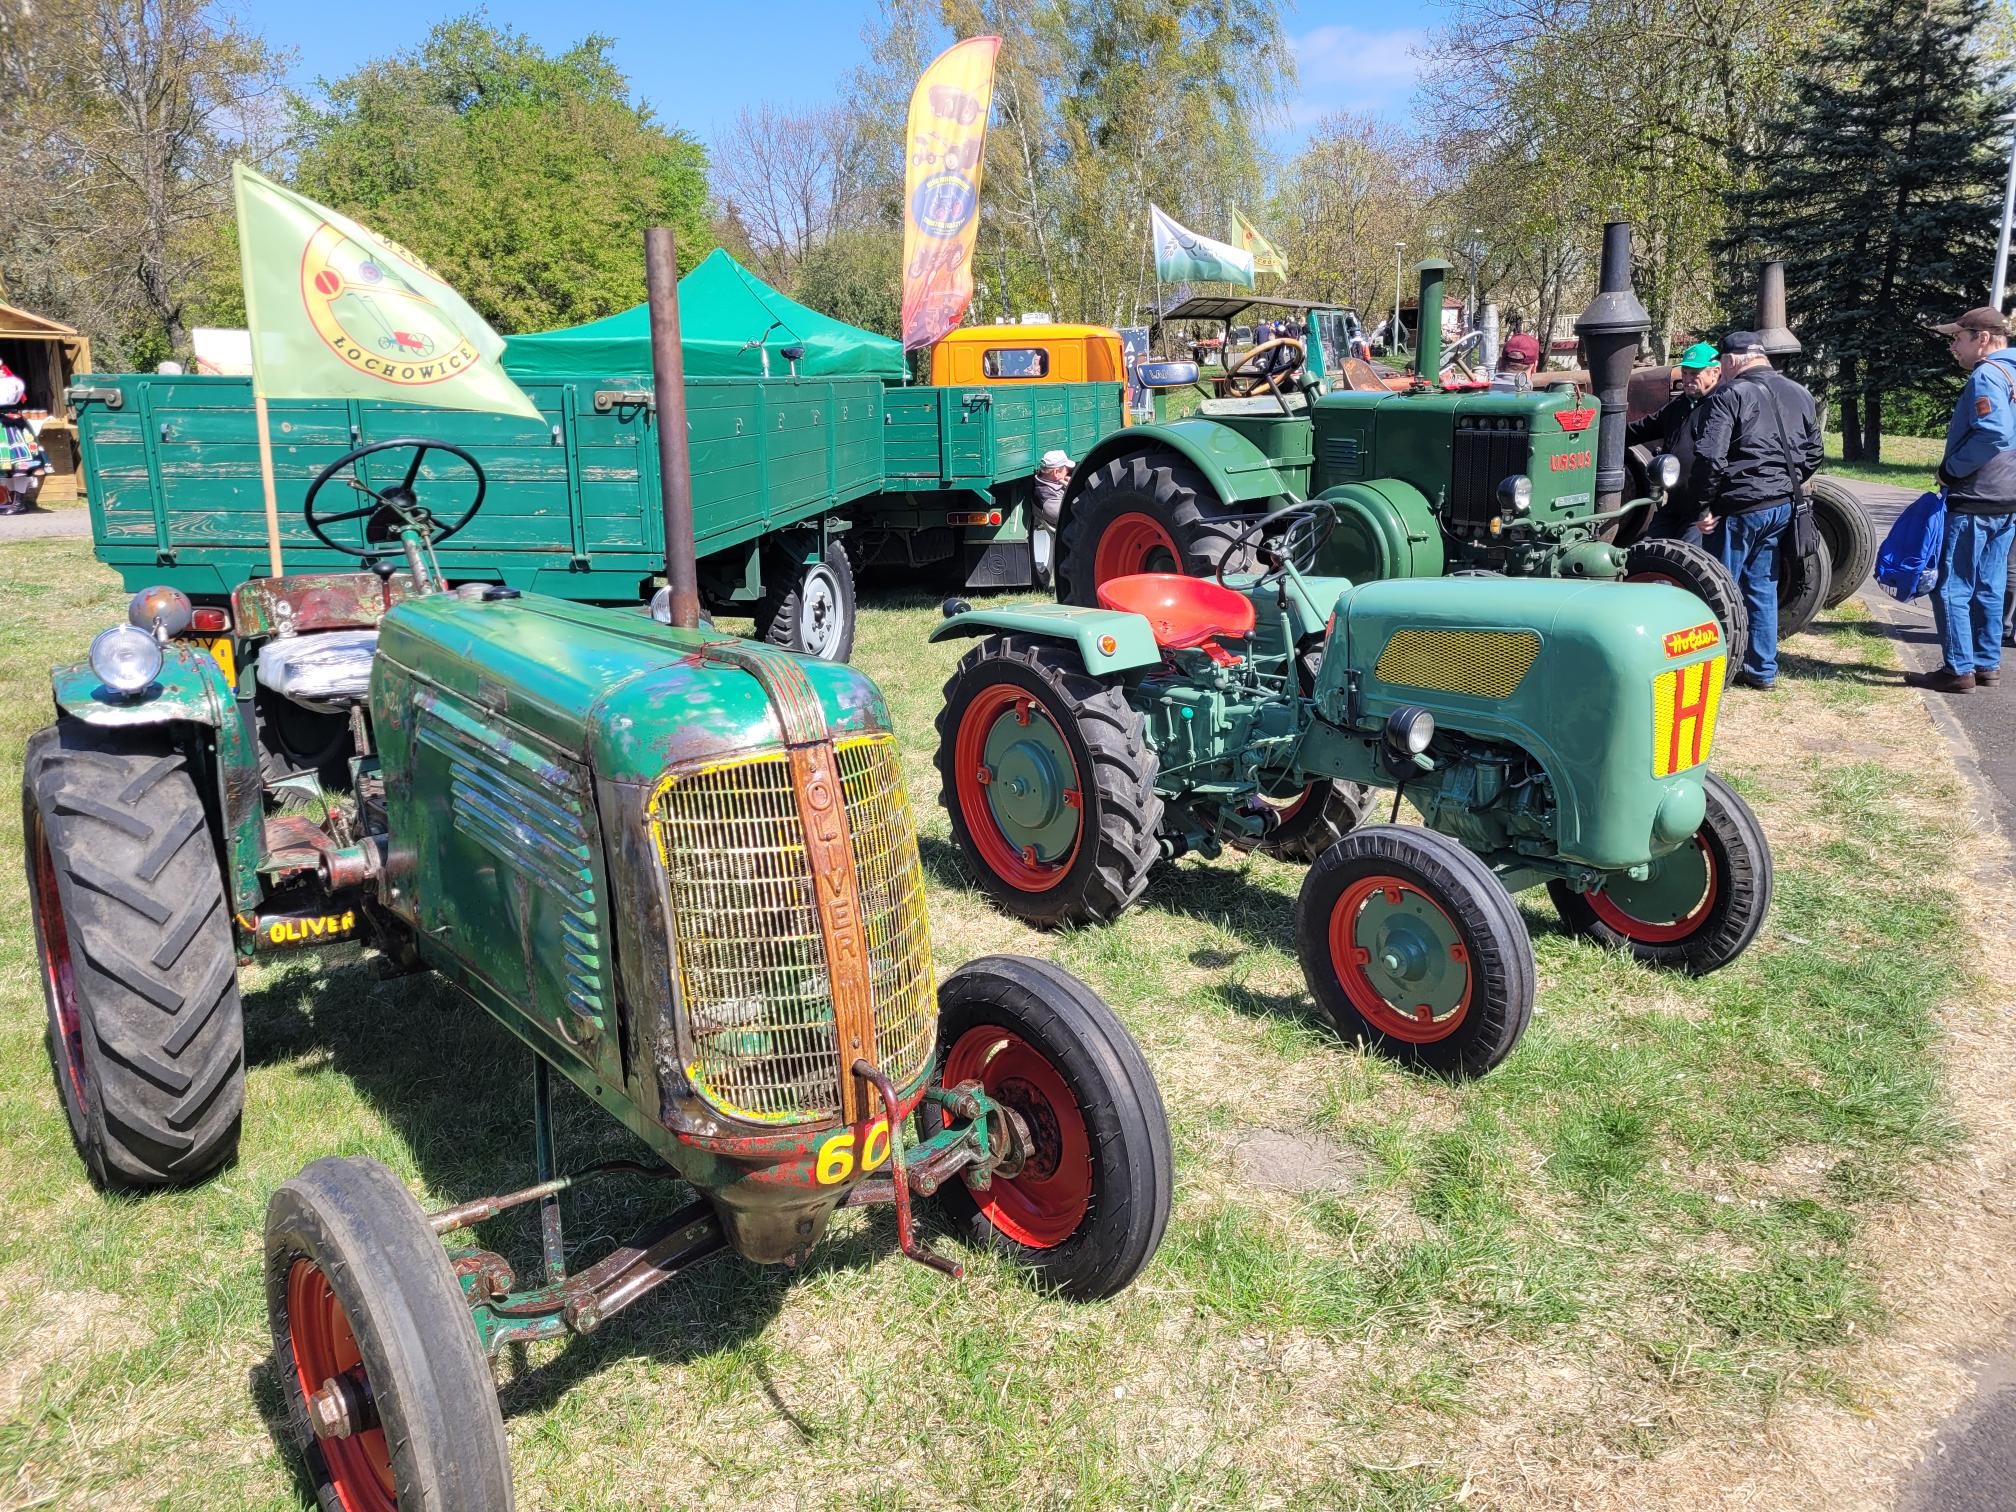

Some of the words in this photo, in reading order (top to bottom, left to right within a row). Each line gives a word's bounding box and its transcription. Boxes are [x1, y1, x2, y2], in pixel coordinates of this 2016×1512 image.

[1551, 450, 1592, 473] URSUS
[1668, 629, 1719, 654] Holder
[1668, 660, 1712, 774] H
[807, 781, 857, 962] OLIVER
[269, 910, 356, 943] OLIVER
[816, 1120, 891, 1185] 60
